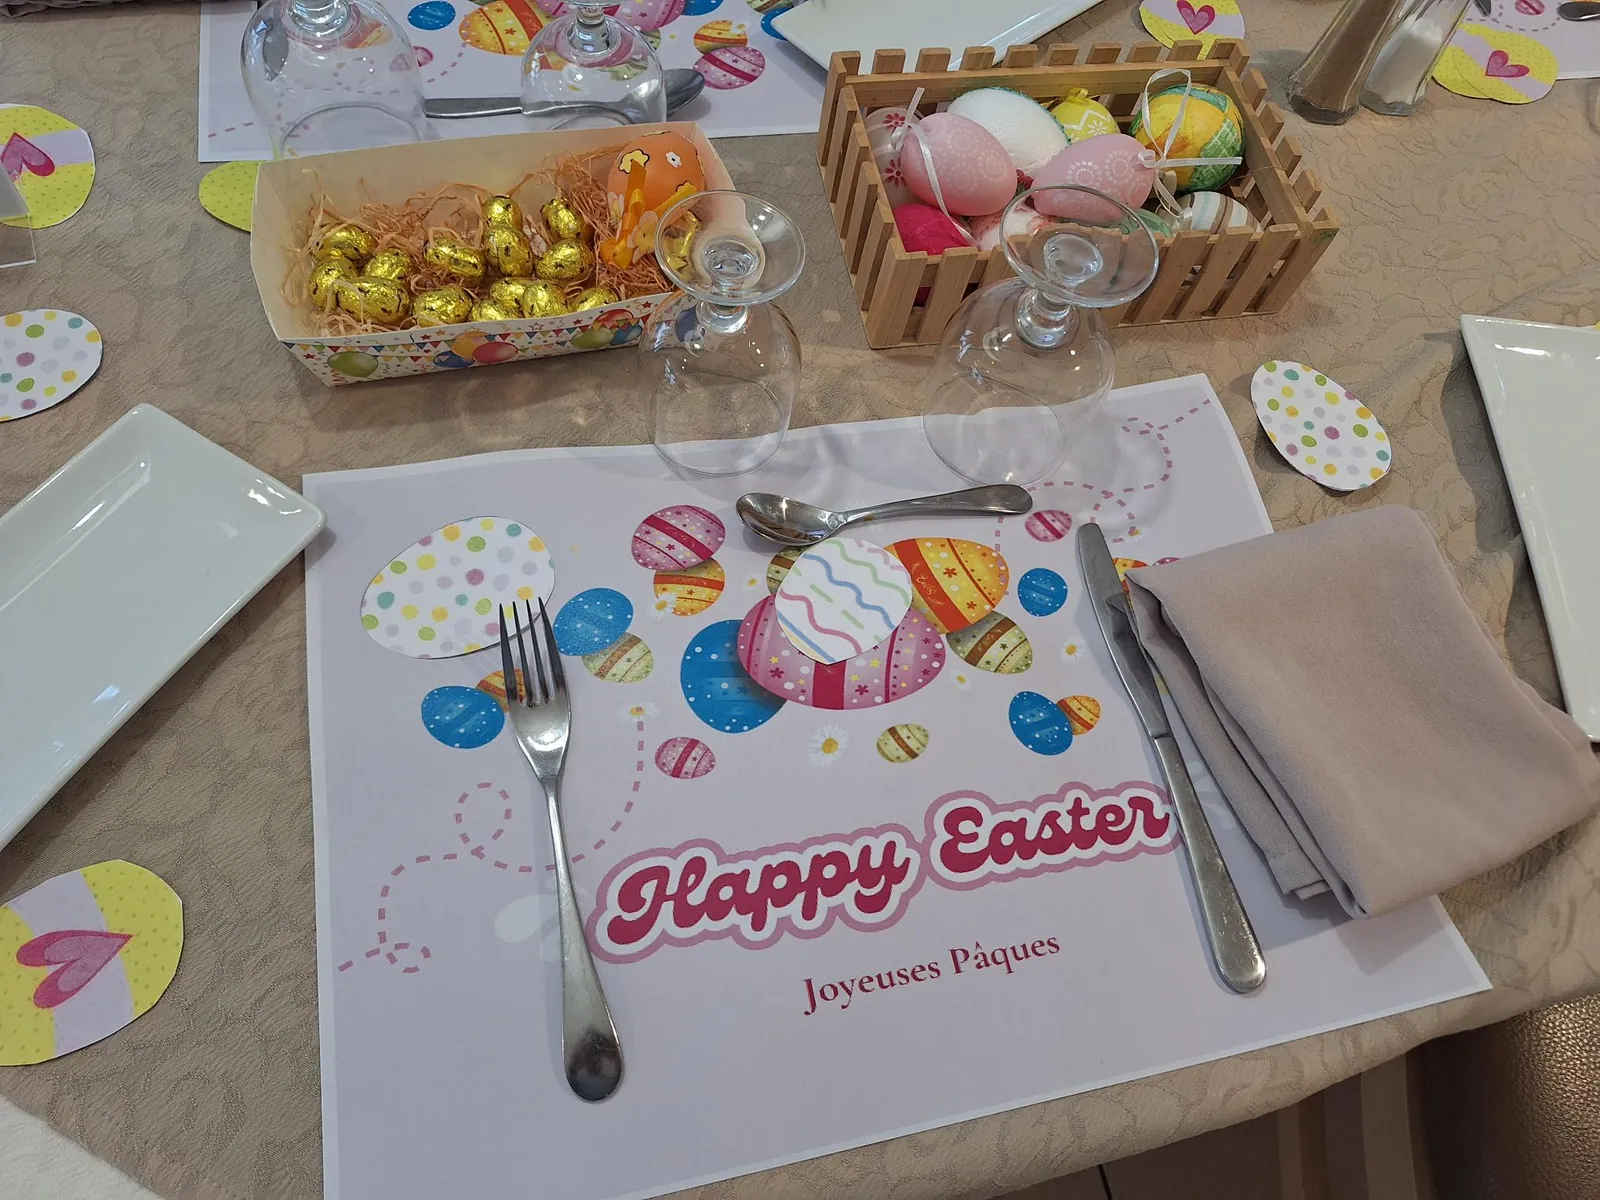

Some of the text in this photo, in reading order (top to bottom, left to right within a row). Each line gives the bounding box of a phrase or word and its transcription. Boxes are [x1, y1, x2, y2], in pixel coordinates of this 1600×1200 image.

[606, 795, 1171, 946] Happy Easter
[803, 934, 1061, 1016] Joyeuses Pâques
